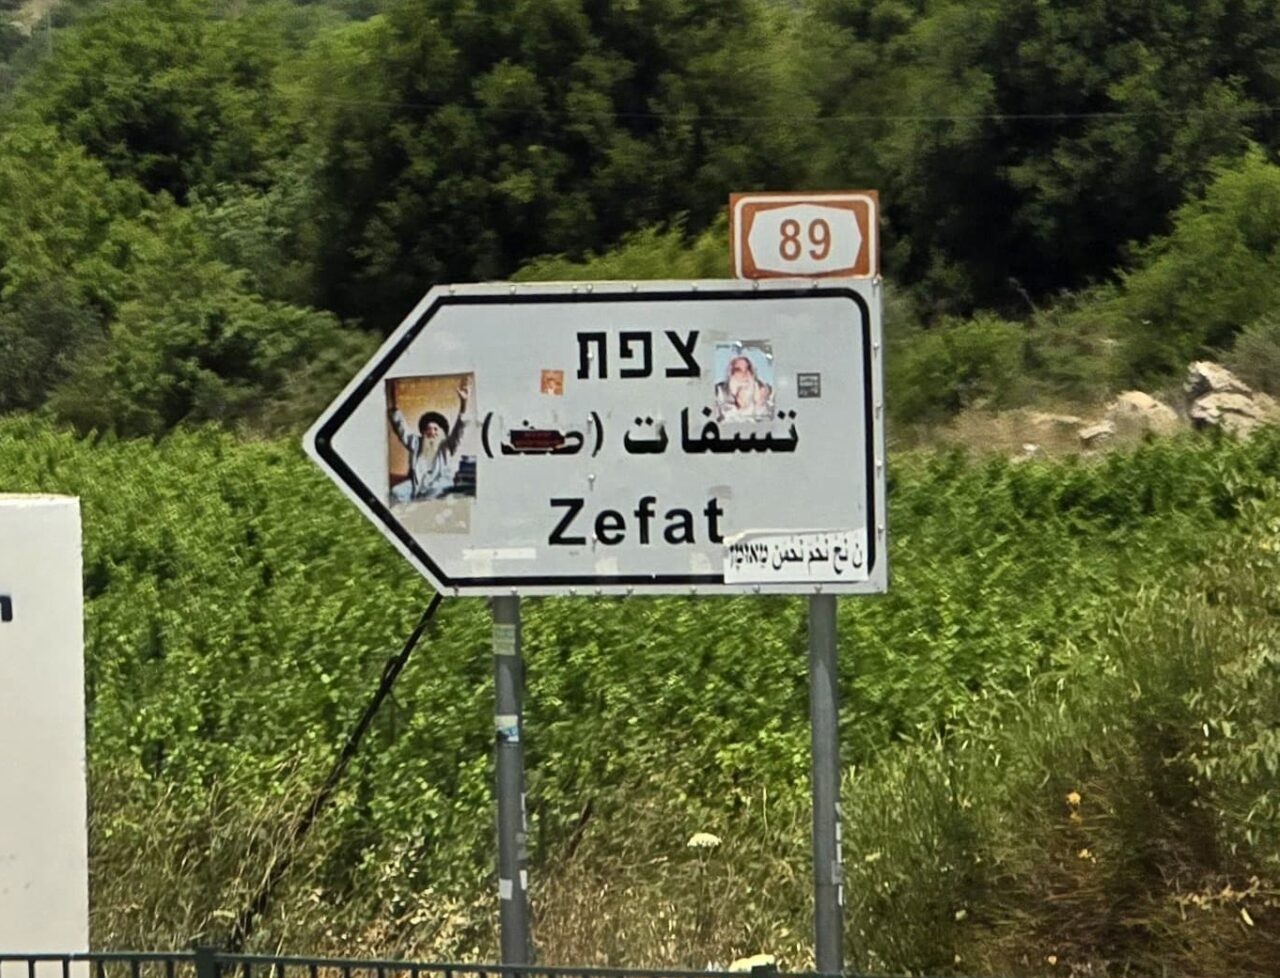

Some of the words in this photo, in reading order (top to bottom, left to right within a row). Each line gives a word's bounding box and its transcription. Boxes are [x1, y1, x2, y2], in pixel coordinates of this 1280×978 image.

[779, 218, 832, 261] 89
[576, 330, 701, 379] צפת
[623, 406, 800, 454] تسفات
[548, 495, 724, 545] Zefat
